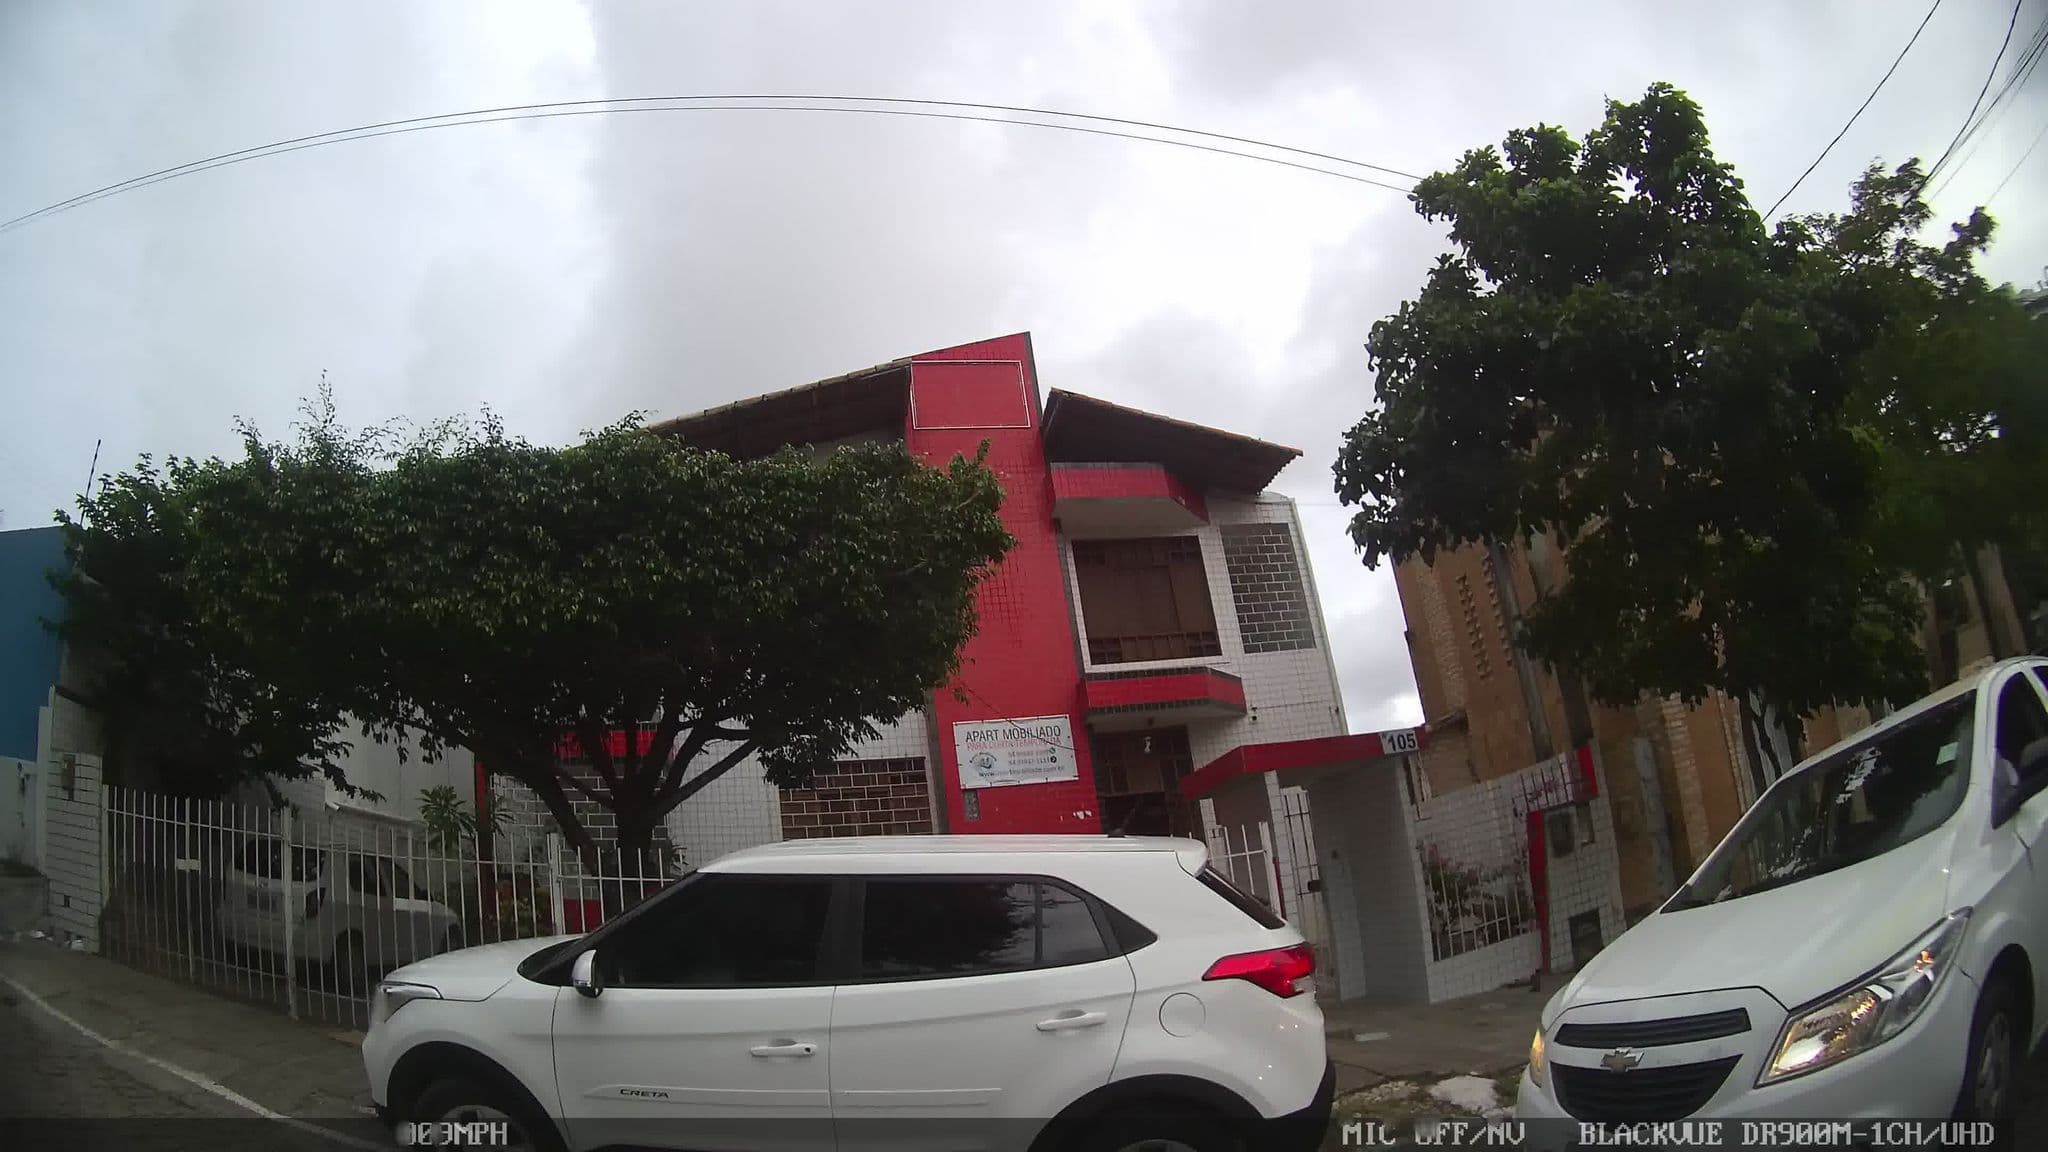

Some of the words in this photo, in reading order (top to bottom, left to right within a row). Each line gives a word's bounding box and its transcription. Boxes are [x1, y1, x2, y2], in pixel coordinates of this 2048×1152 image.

[965, 729, 999, 743] APART
[1002, 725, 1062, 741] MOBILIADO
[1387, 733, 1416, 752] 105
[619, 1088, 671, 1099] CRETA
